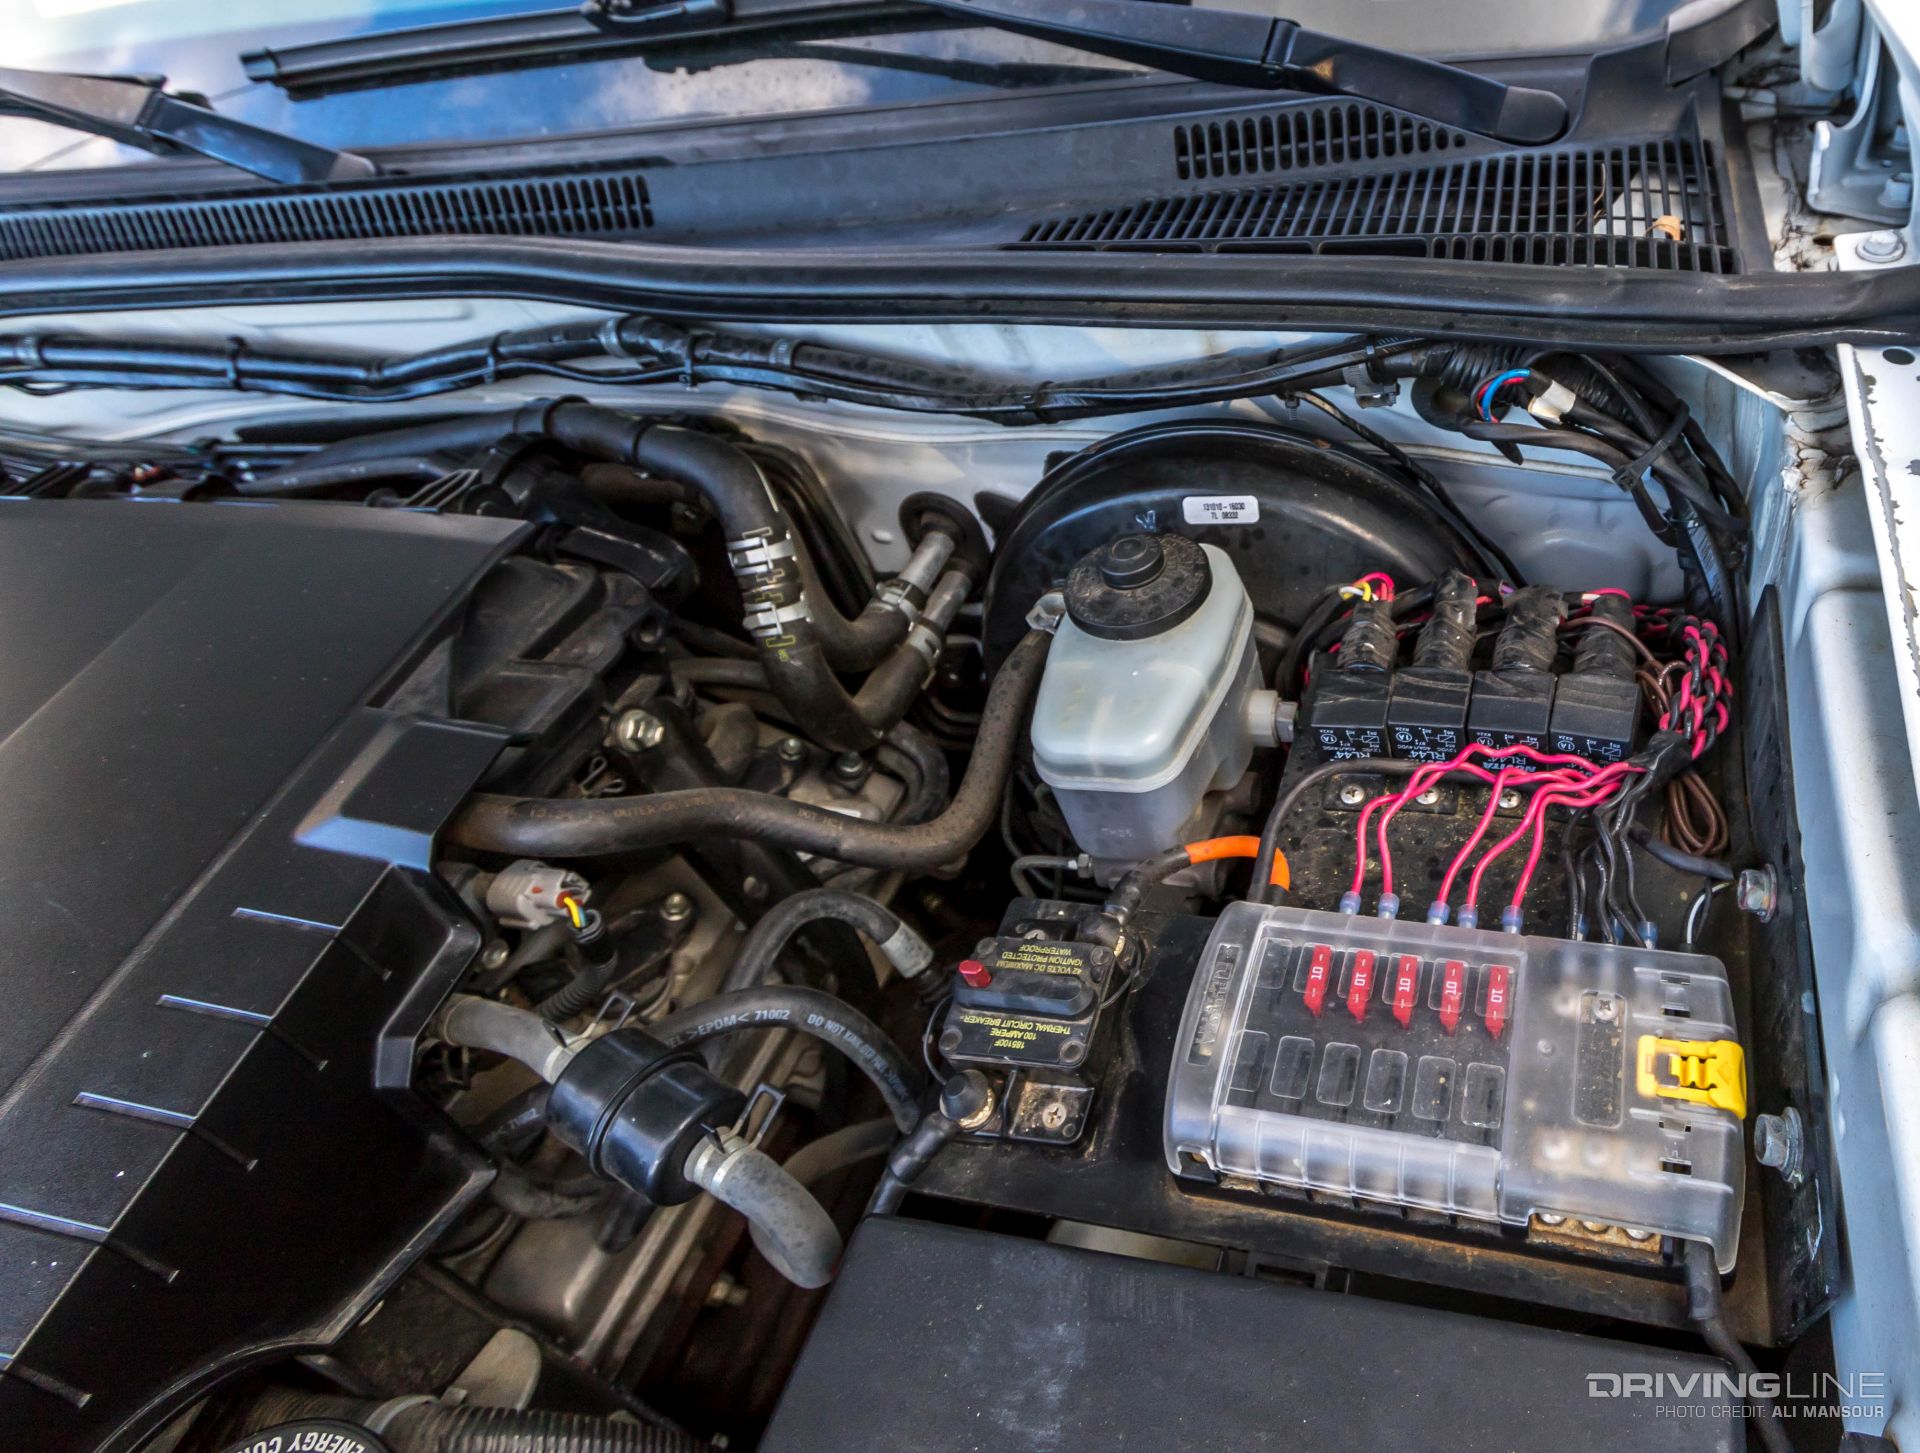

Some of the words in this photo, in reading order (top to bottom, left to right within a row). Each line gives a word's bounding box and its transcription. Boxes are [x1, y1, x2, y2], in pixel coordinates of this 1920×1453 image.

[1018, 944, 1072, 956] WATERPROOF
[1002, 951, 1048, 962] PROTECTED
[1048, 955, 1083, 966] IGNITION
[996, 960, 1033, 970] MAXIMUM
[1034, 964, 1047, 972] DC
[1047, 965, 1071, 974] VOLTS
[1311, 966, 1323, 980] 10
[1354, 972, 1367, 986] 10
[1399, 978, 1411, 992] 10
[1446, 981, 1458, 995] 10
[1491, 988, 1504, 1003] 10
[754, 1009, 791, 1021] 71002
[807, 1013, 824, 1026] DO
[964, 1015, 1001, 1027] BREAKER
[1001, 1019, 1034, 1031] CIRCUIT
[1035, 1023, 1071, 1035] THERMAL
[990, 1027, 1024, 1039] AMPERE
[1023, 1031, 1037, 1040] 100
[994, 1039, 1025, 1049] 185100F
